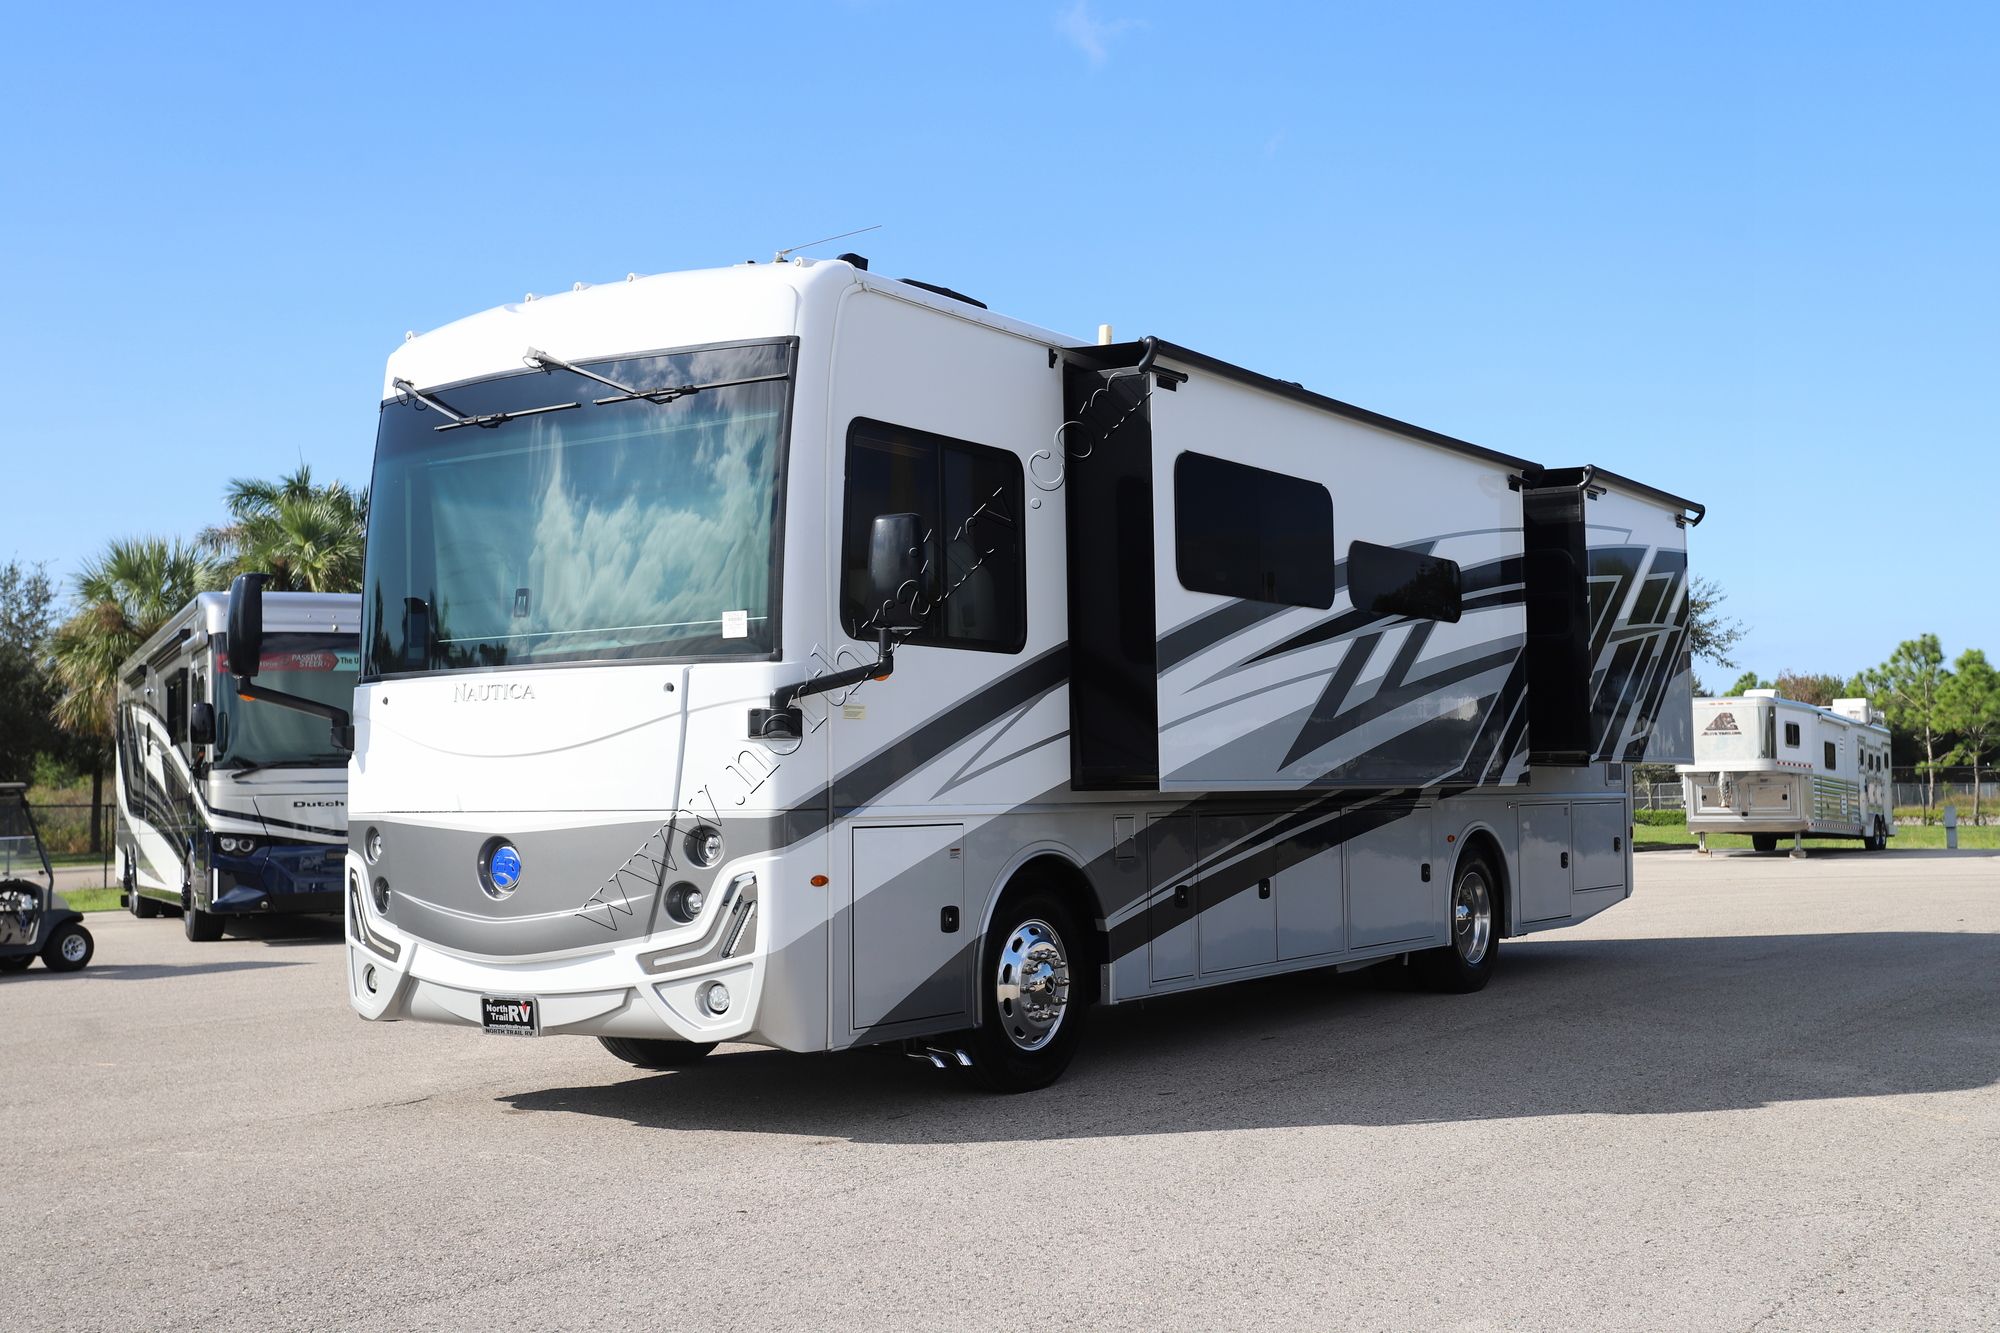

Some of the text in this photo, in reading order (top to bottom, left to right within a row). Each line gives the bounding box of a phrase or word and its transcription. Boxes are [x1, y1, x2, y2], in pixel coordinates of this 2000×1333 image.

[340, 656, 353, 665] The
[453, 682, 536, 703] NAUTICA
[486, 1004, 508, 1013] North
[490, 1013, 508, 1021] Trail
[508, 1005, 531, 1022] RV
